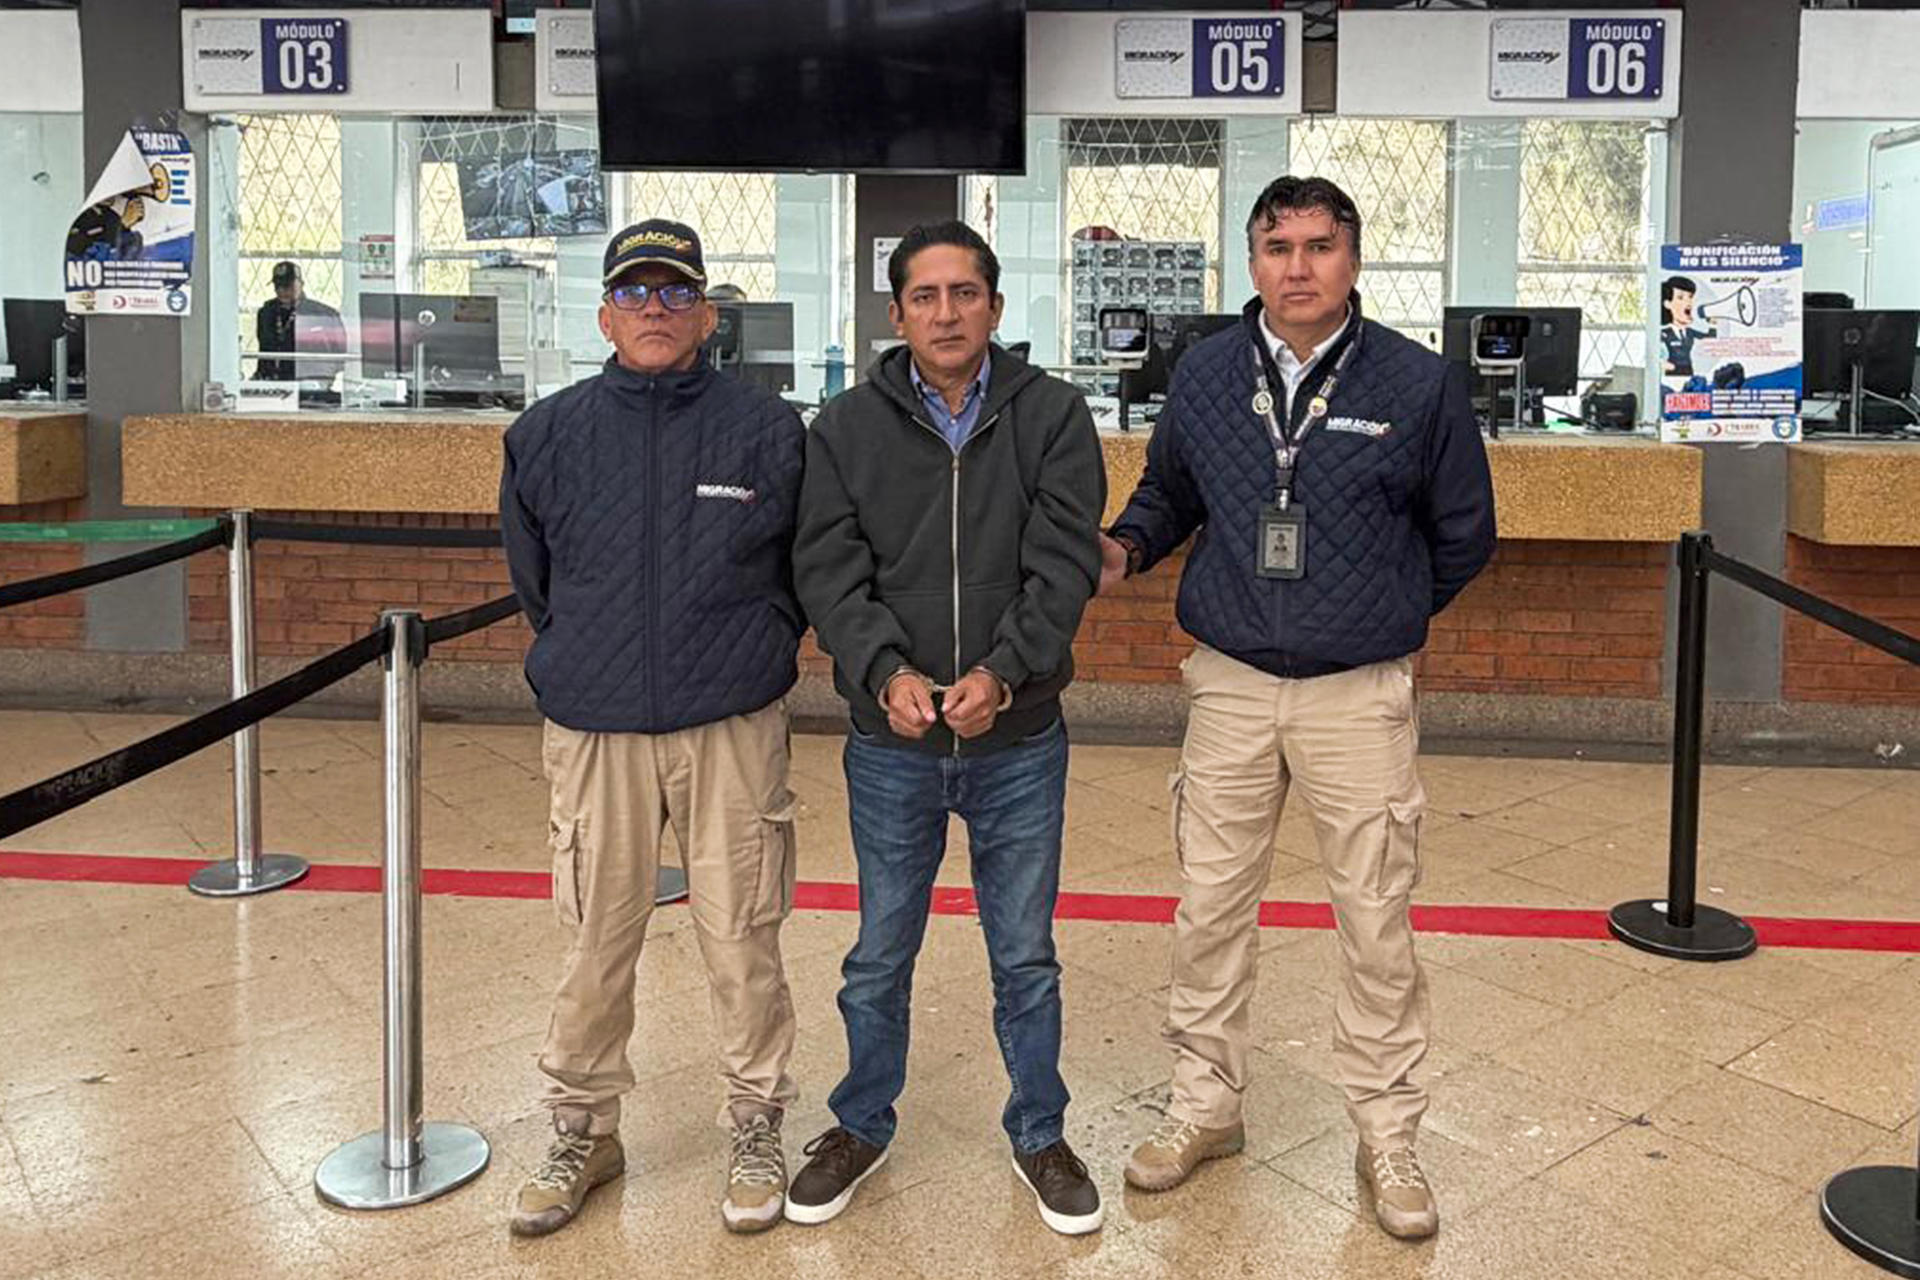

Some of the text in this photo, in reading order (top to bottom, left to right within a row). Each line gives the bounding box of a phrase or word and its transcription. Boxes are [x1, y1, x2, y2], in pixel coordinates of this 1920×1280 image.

[276, 22, 334, 39] MÓDULO
[1208, 24, 1273, 40] MÓDULO
[1586, 24, 1652, 41] MÓDULO
[279, 40, 333, 89] 03
[1211, 41, 1269, 92] 05
[1587, 42, 1646, 94] 06
[1680, 257, 1699, 267] NO
[1702, 257, 1718, 267] ES
[67, 260, 103, 288] NO
